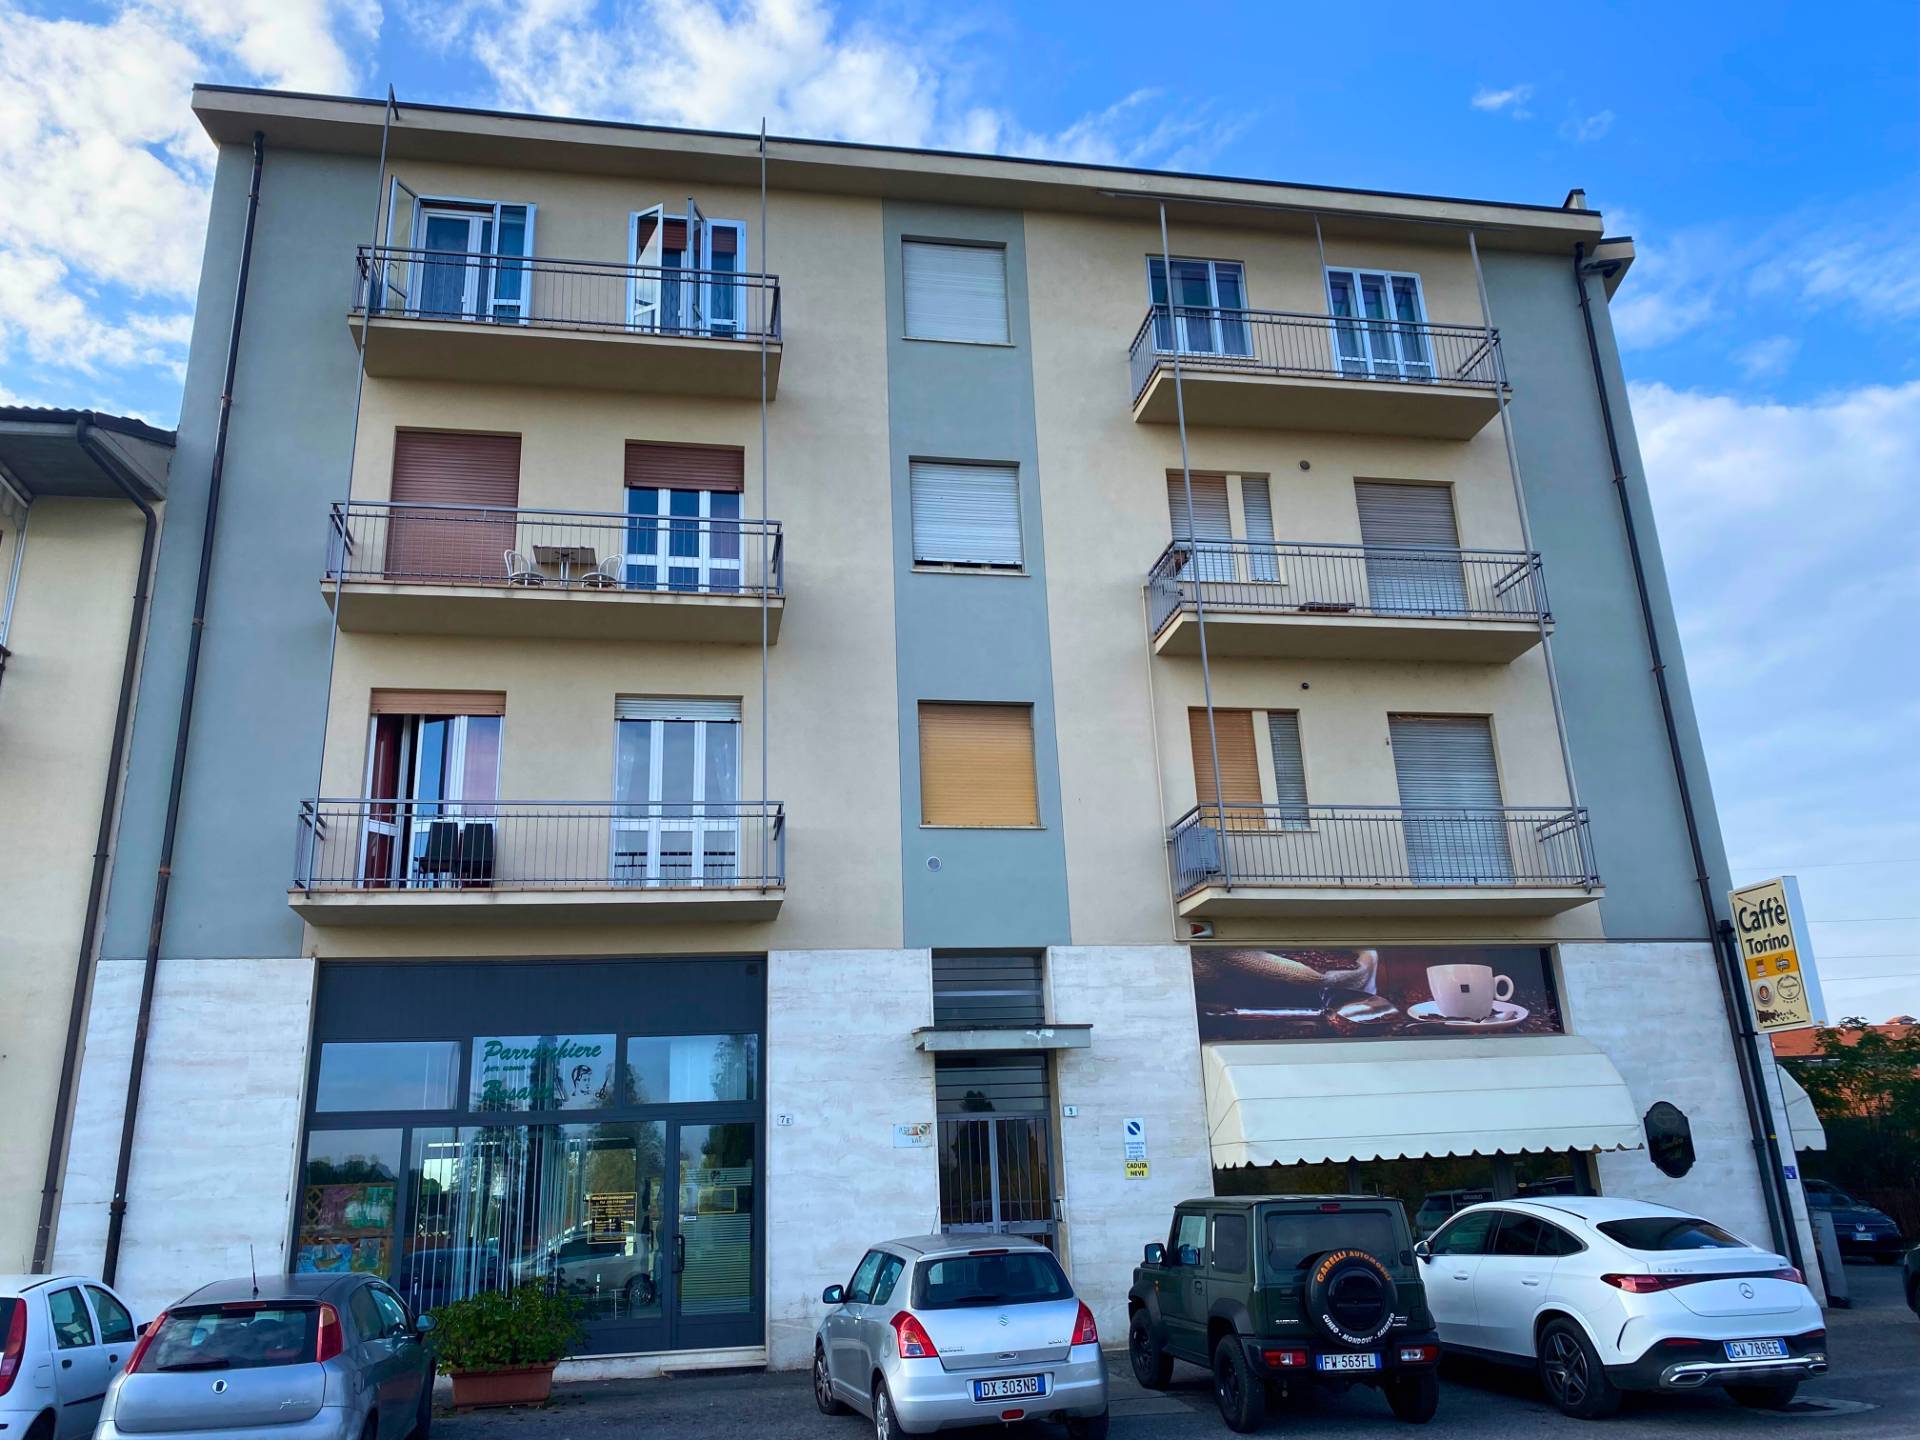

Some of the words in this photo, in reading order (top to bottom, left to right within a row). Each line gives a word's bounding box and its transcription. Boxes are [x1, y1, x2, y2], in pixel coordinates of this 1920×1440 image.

[1738, 896, 1787, 934] Caffè
[1745, 933, 1790, 955] Torino
[1316, 1250, 1347, 1282] GARELLI
[1324, 1355, 1338, 1369] FW
[1341, 1353, 1376, 1369] 563FL
[983, 1382, 998, 1396] DX
[1002, 1378, 1037, 1393] 303NB
